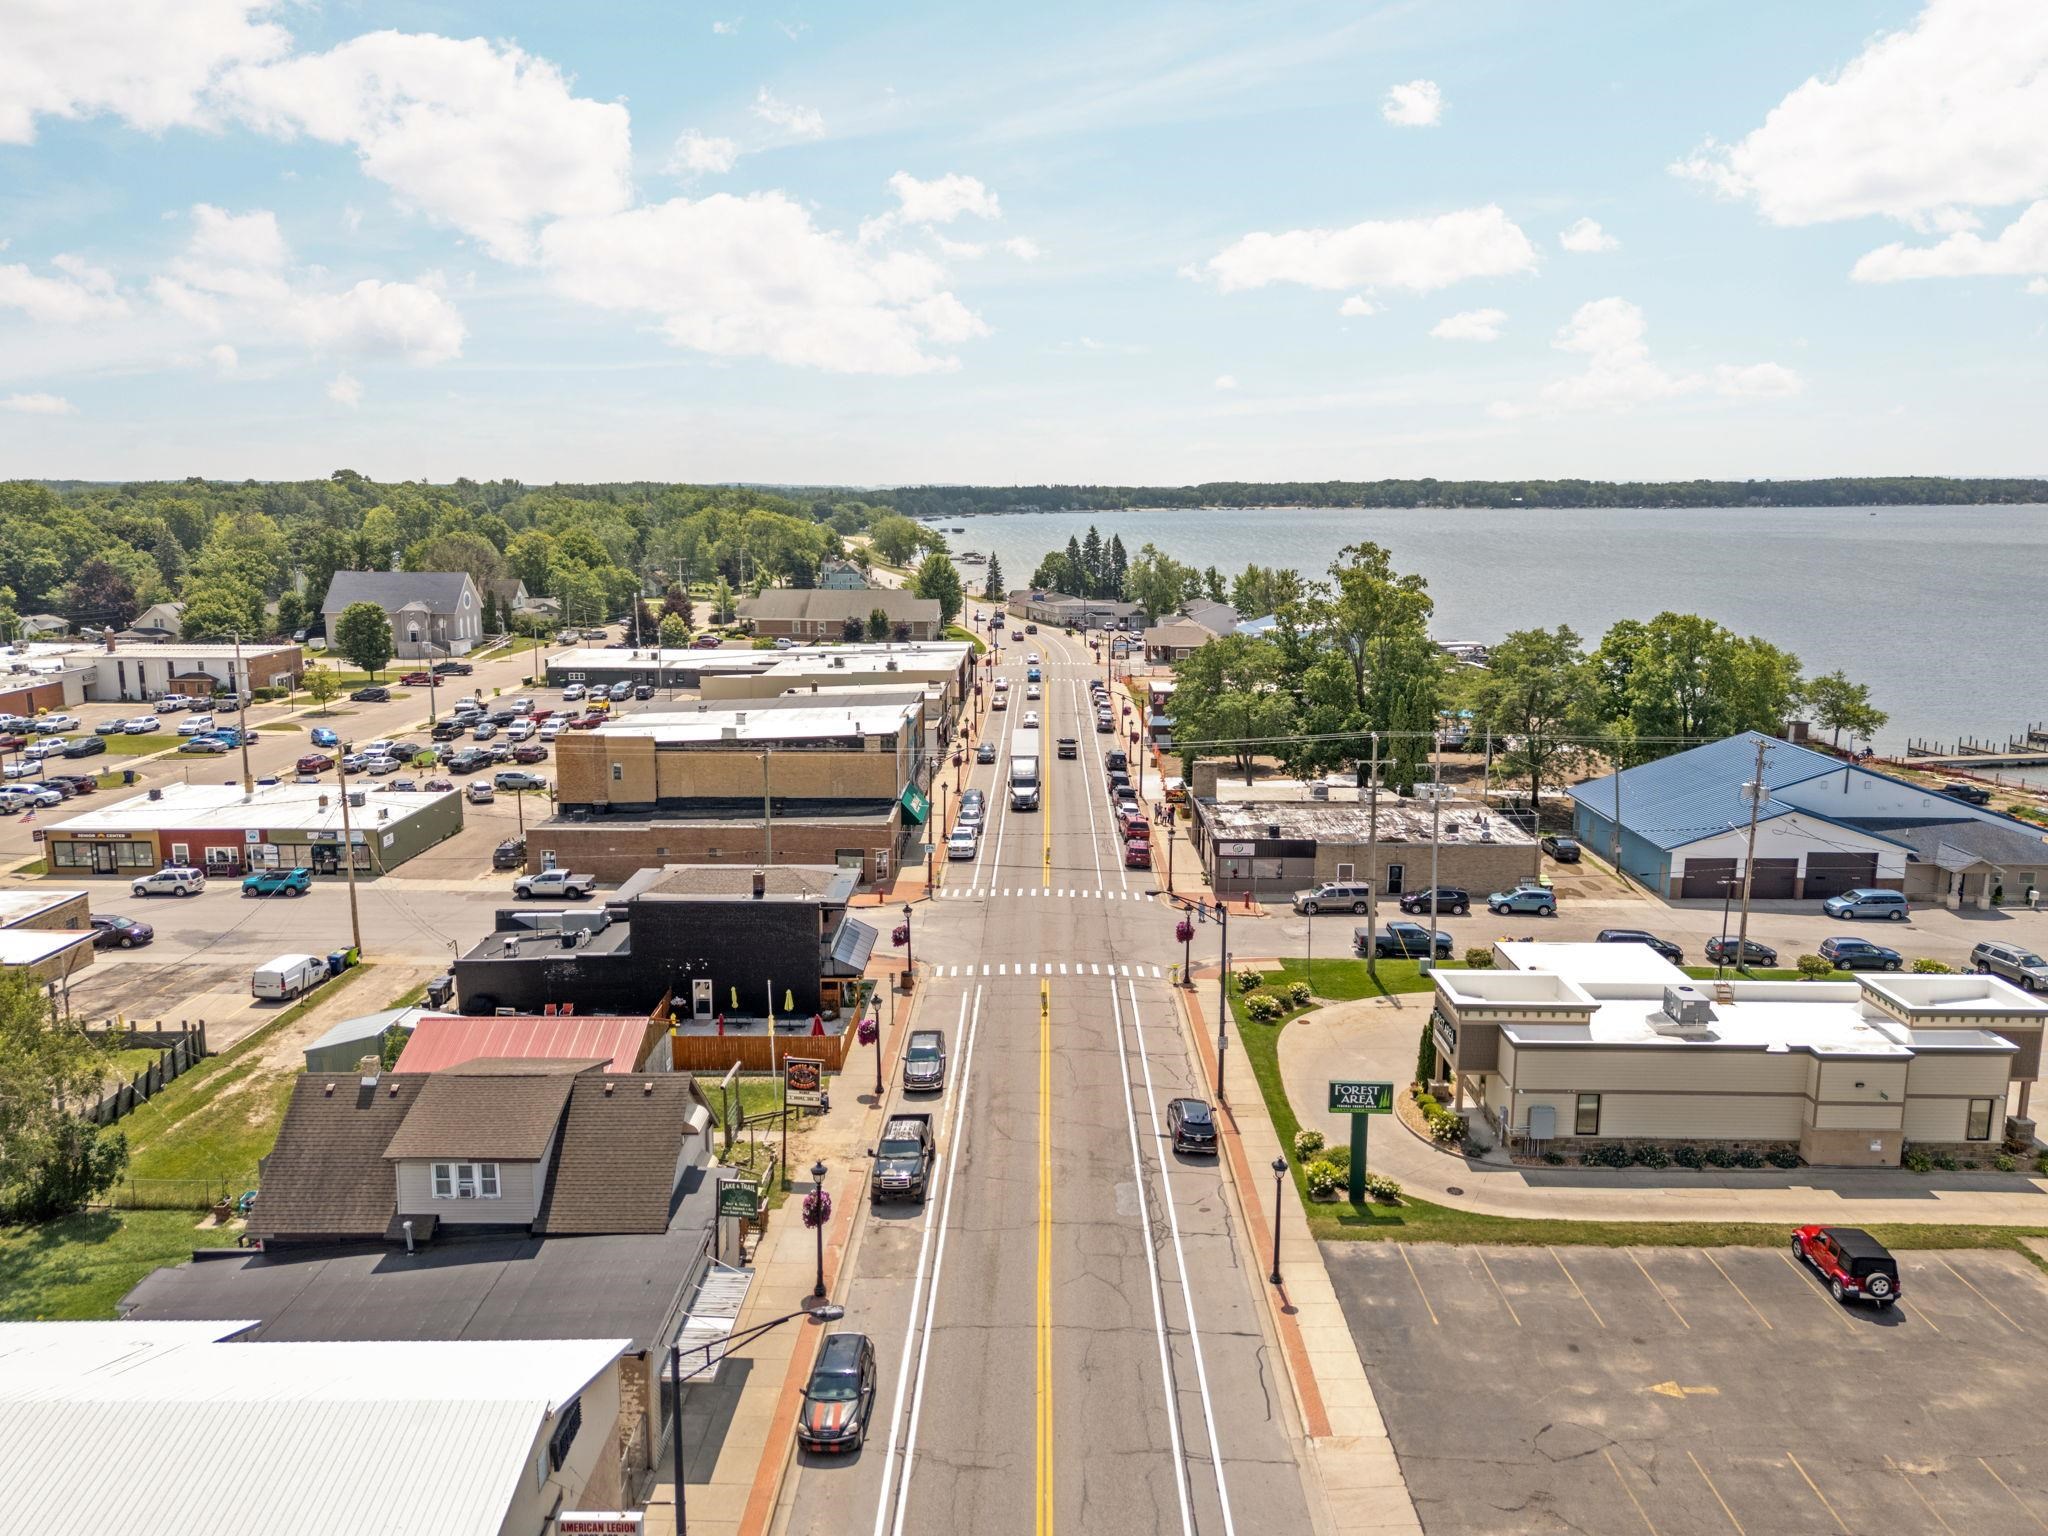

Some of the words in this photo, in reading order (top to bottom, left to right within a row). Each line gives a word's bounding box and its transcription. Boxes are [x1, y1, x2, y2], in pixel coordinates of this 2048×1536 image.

[1334, 1084, 1380, 1095] FOREST
[1341, 1094, 1374, 1105] AREA
[721, 1181, 736, 1190] LAKE
[740, 1182, 756, 1192] TRAIL
[560, 1522, 604, 1532] AMERICAN
[607, 1522, 636, 1533] LEGION
